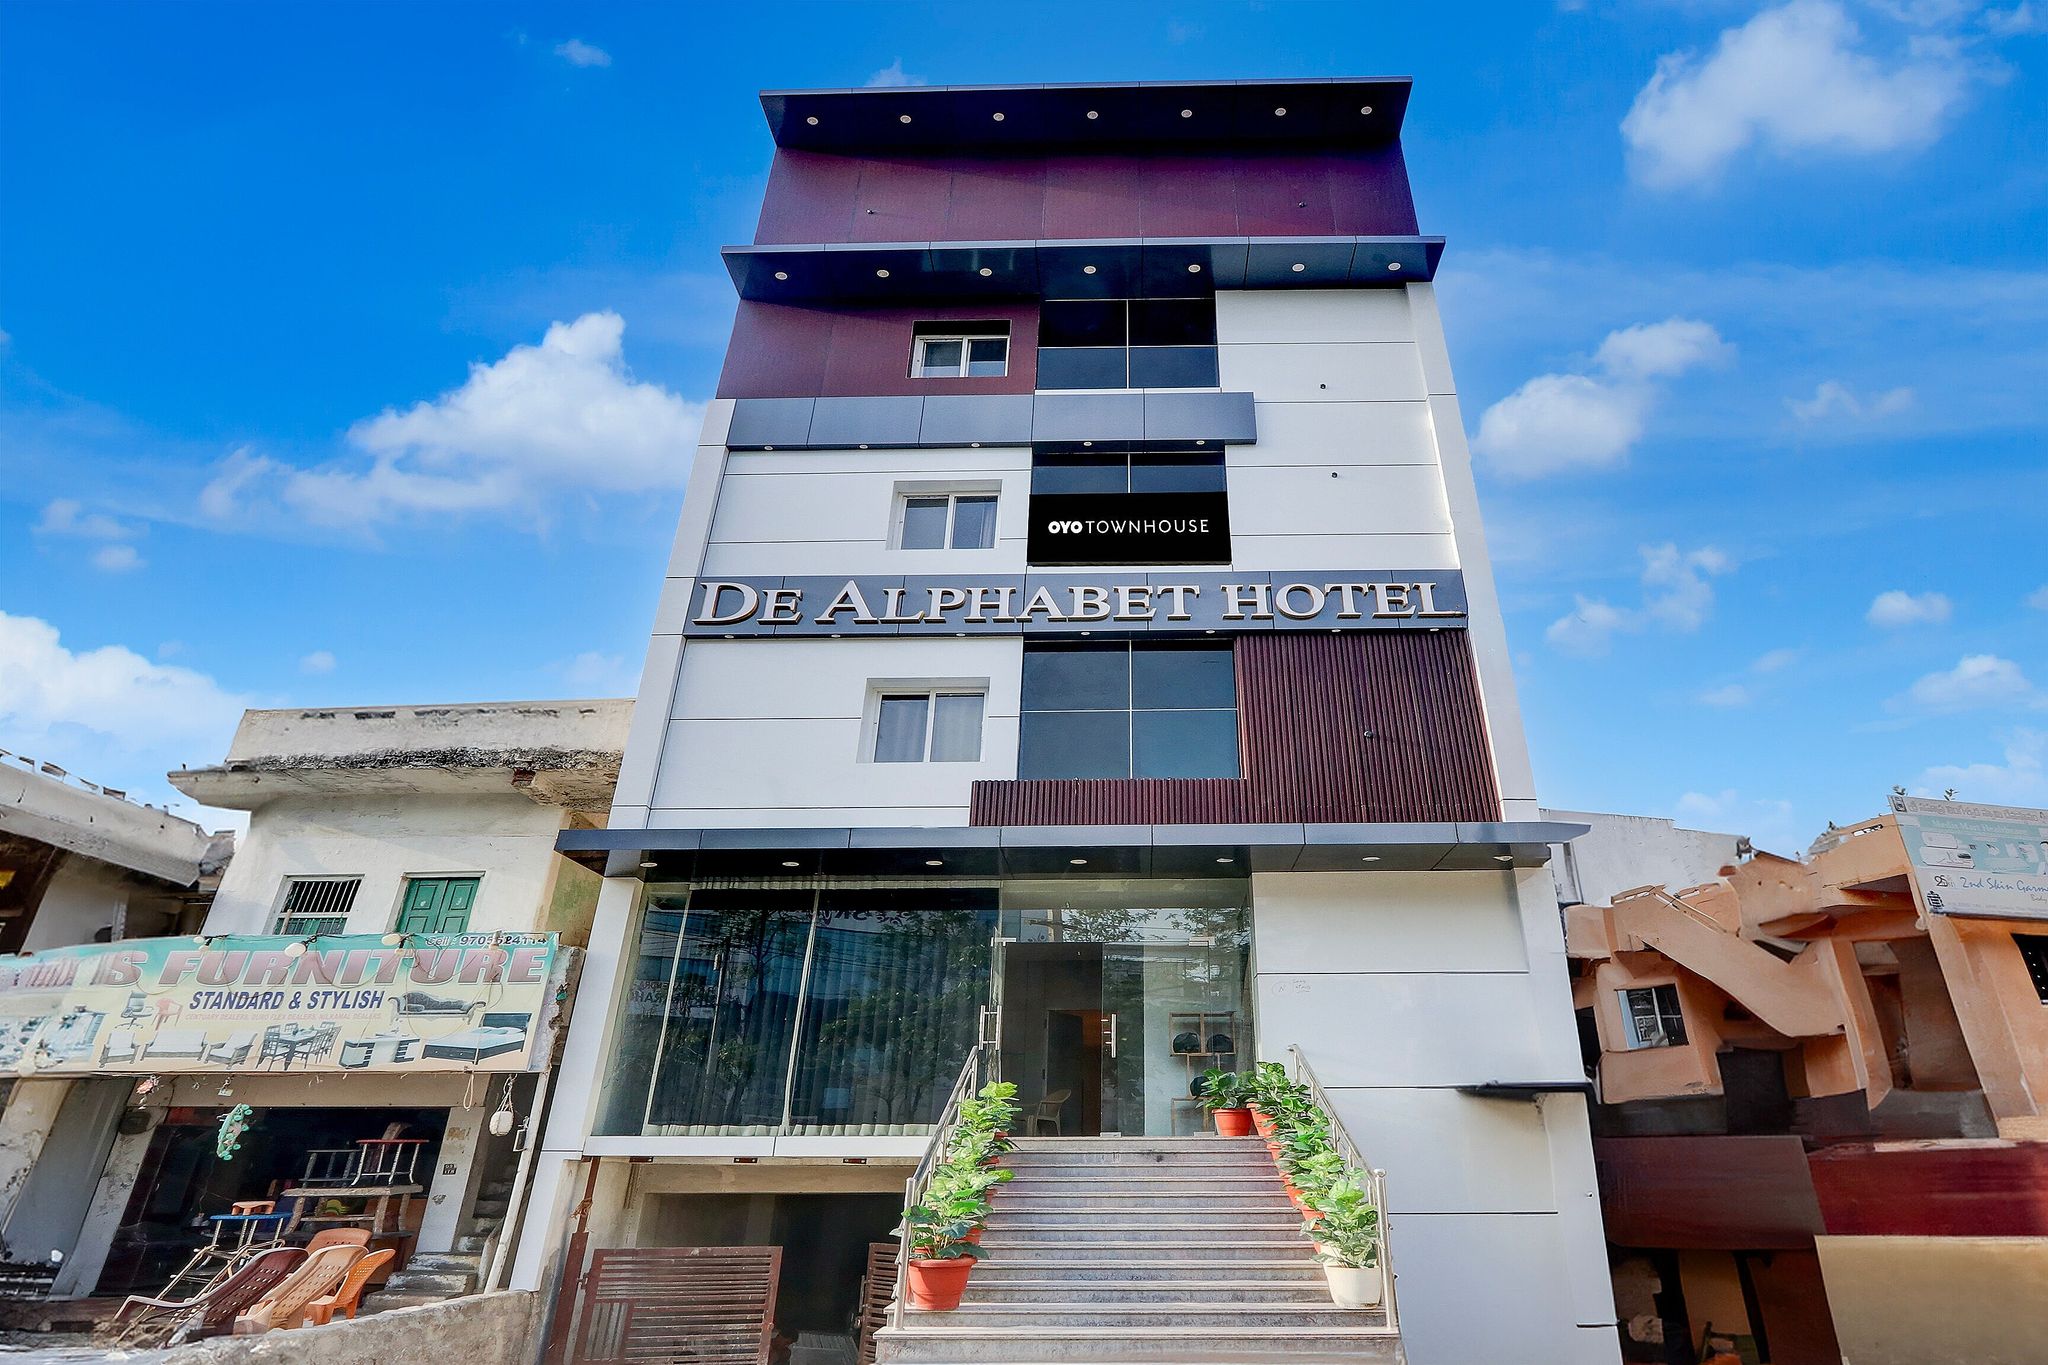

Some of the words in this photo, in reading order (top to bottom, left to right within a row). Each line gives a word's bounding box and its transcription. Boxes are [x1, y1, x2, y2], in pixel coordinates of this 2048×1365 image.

[1047, 520, 1083, 534] OYO
[1085, 519, 1210, 534] TOWNHOUSE
[692, 582, 804, 626] DE
[814, 580, 1200, 625] ALPHABET
[1220, 582, 1467, 620] HOTEL
[158, 947, 549, 988] FURNITURE
[189, 991, 285, 1010] STANDARD
[288, 990, 301, 1010] &
[307, 990, 385, 1009] STYLISH
